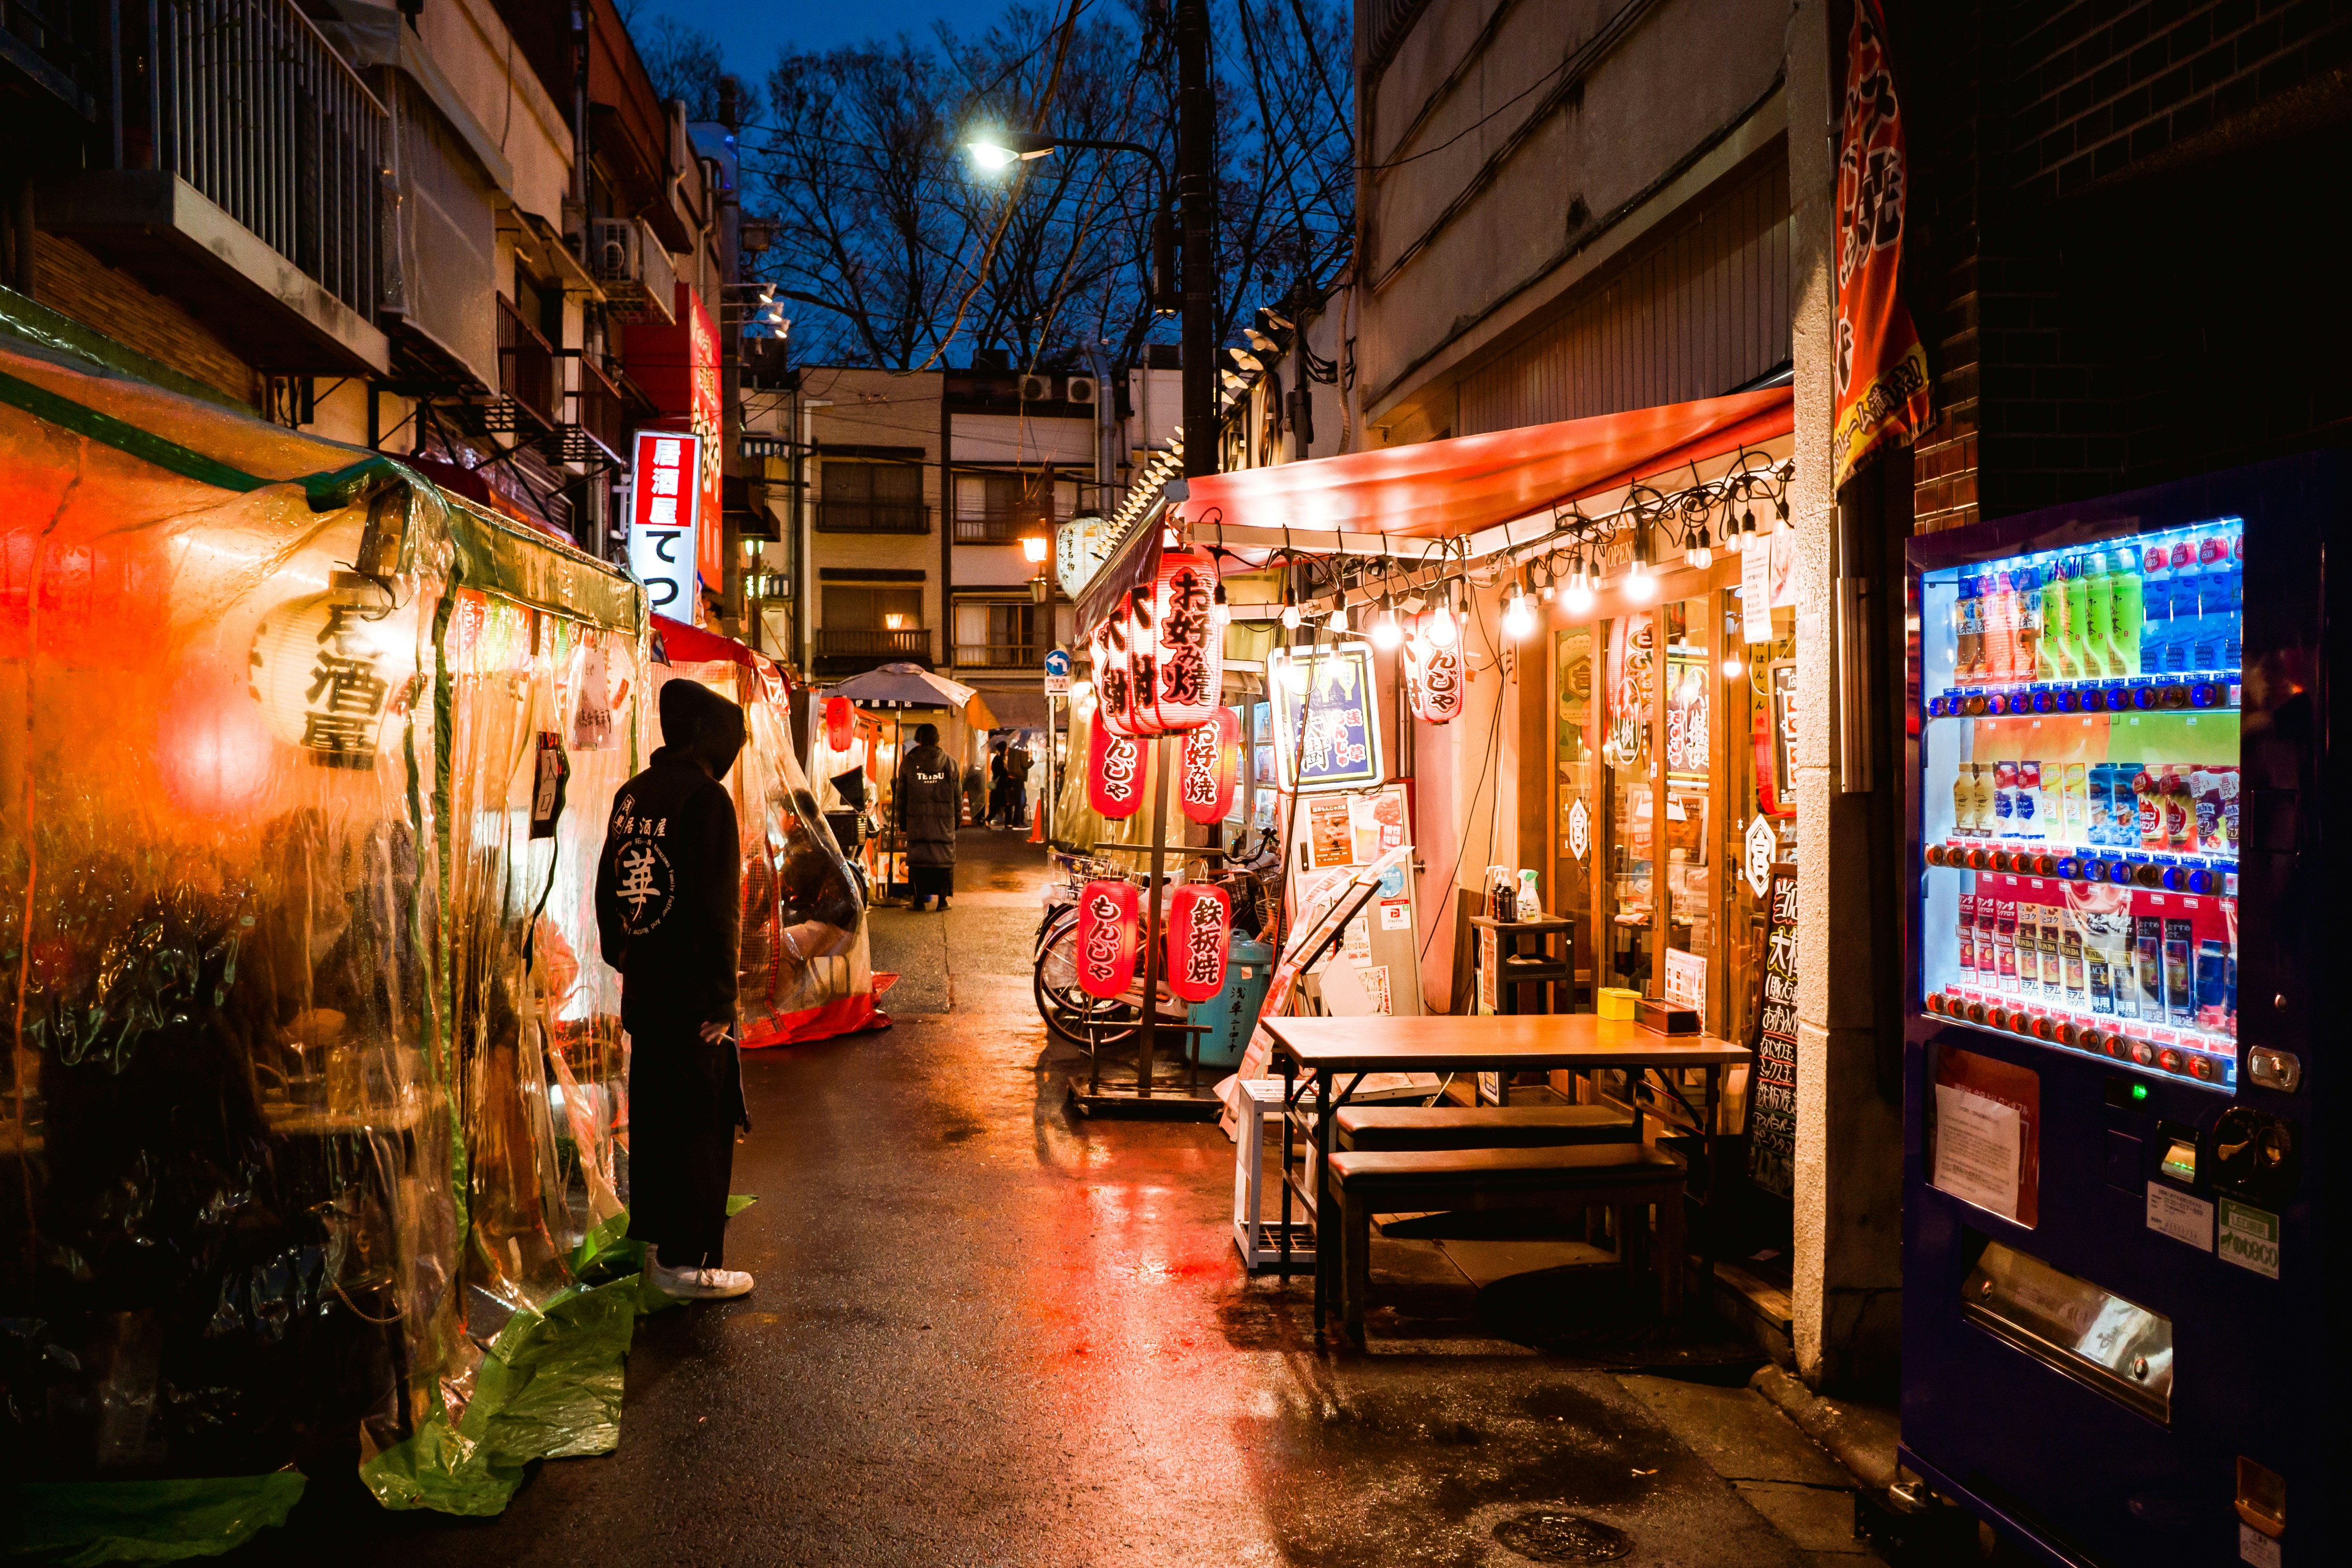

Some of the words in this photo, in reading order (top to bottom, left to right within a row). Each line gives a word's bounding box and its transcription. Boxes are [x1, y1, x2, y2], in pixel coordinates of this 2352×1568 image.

[651, 439, 681, 524] 居酒屋
[643, 530, 681, 606] てつ
[1162, 573, 1212, 702] お好み焼
[301, 604, 389, 752] 居酒屋
[1104, 736, 1135, 799] んじゃ
[1186, 725, 1218, 803] お好み焼
[1346, 709, 1365, 761] 浅草
[623, 817, 667, 837] 居酒屋
[2196, 804, 2214, 812] elch's
[616, 847, 661, 921] 華
[1088, 897, 1120, 980] もんじゃ
[1187, 899, 1222, 983] 鉄板焼
[2067, 992, 2085, 1000] ミアム
